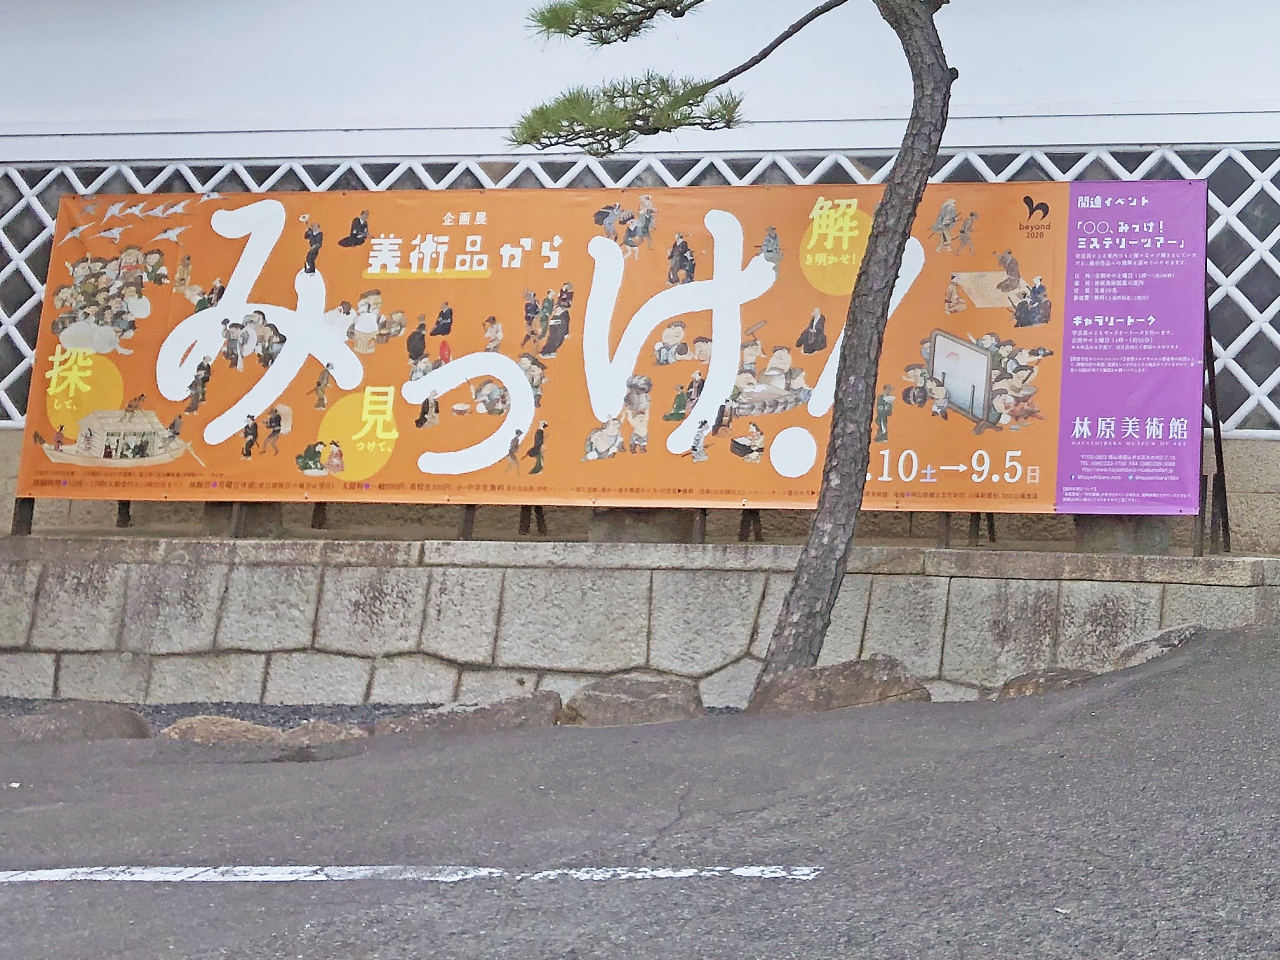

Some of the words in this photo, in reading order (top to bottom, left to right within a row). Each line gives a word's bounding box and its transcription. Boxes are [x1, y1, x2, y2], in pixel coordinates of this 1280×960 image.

[1077, 196, 1149, 208] 関連イベント
[441, 211, 488, 226] 企画展
[807, 196, 859, 250] 解
[1018, 222, 1051, 232] beyond
[367, 233, 563, 274] 美術品から
[1073, 315, 1156, 326] ギャラリートーク
[45, 345, 94, 396] 探
[352, 386, 399, 441] 見
[1070, 416, 1188, 439] 林原美術館
